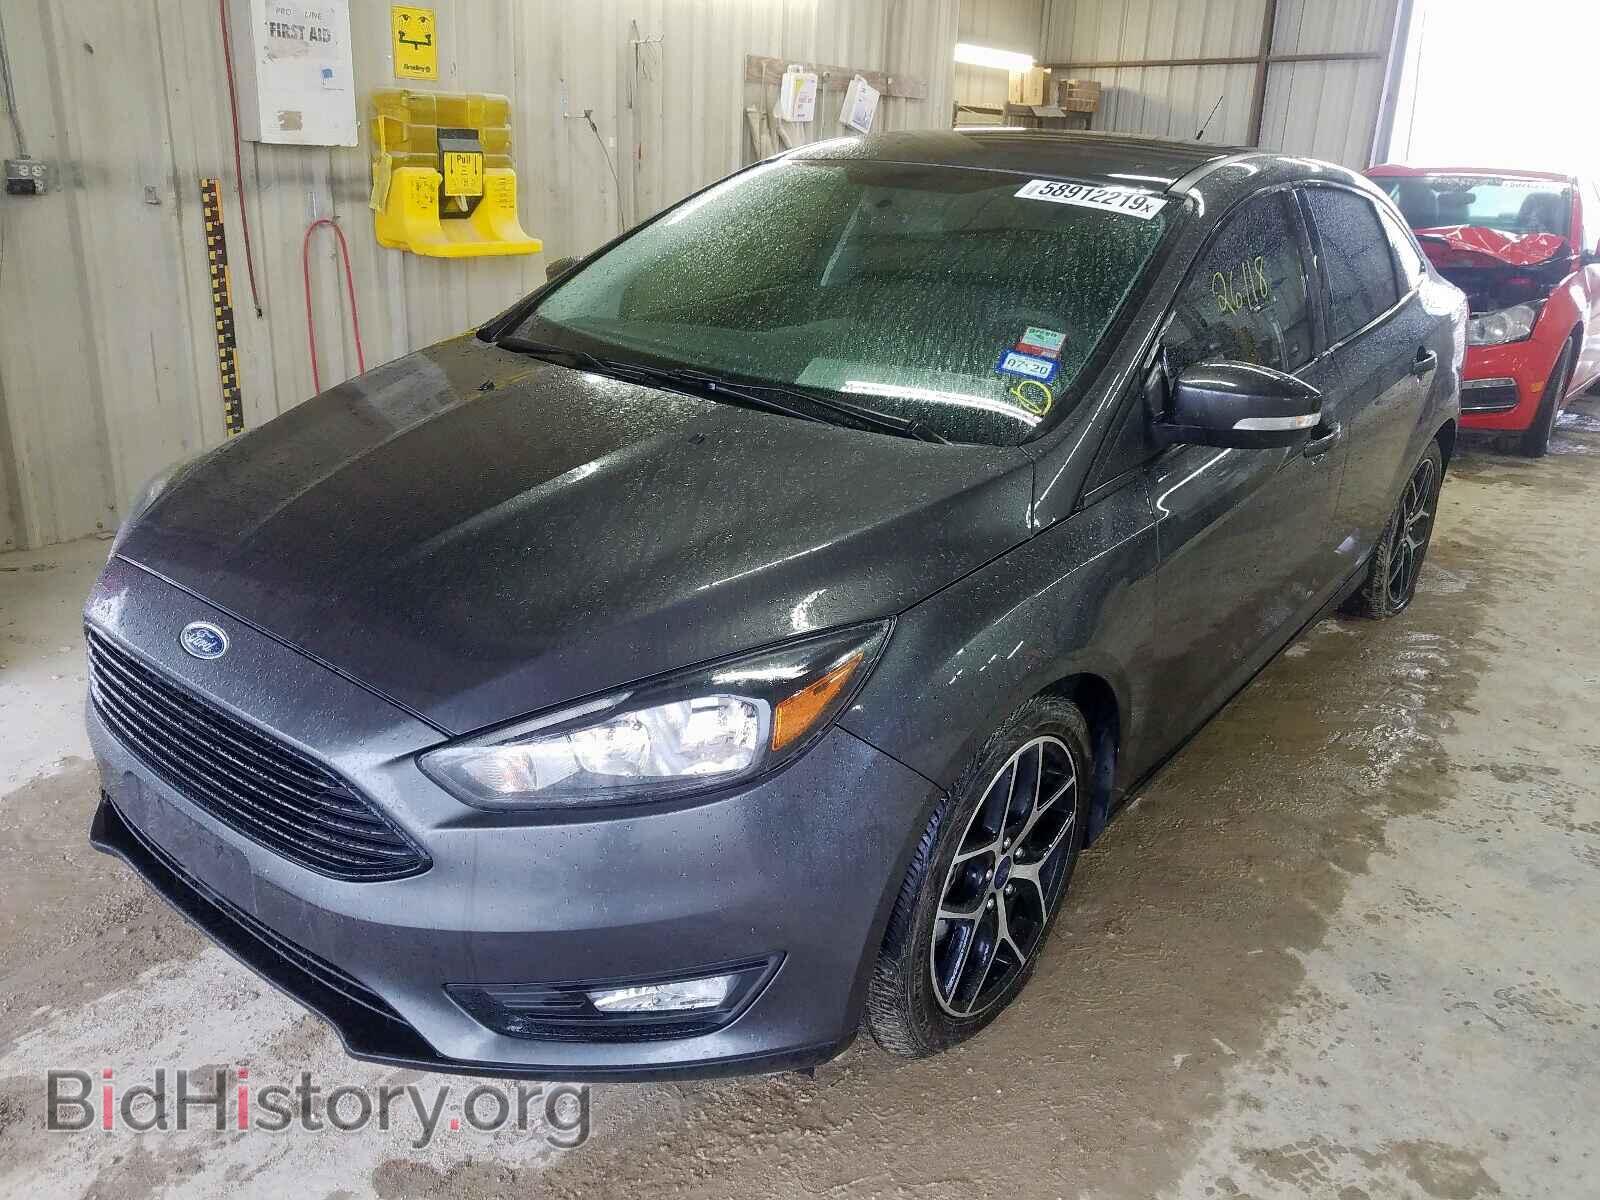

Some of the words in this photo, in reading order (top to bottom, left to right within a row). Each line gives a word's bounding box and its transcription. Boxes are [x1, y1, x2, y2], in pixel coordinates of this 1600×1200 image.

[269, 22, 305, 40] FIRST
[309, 27, 331, 43] AID
[456, 154, 471, 165] Pull
[187, 629, 218, 653] Ford
